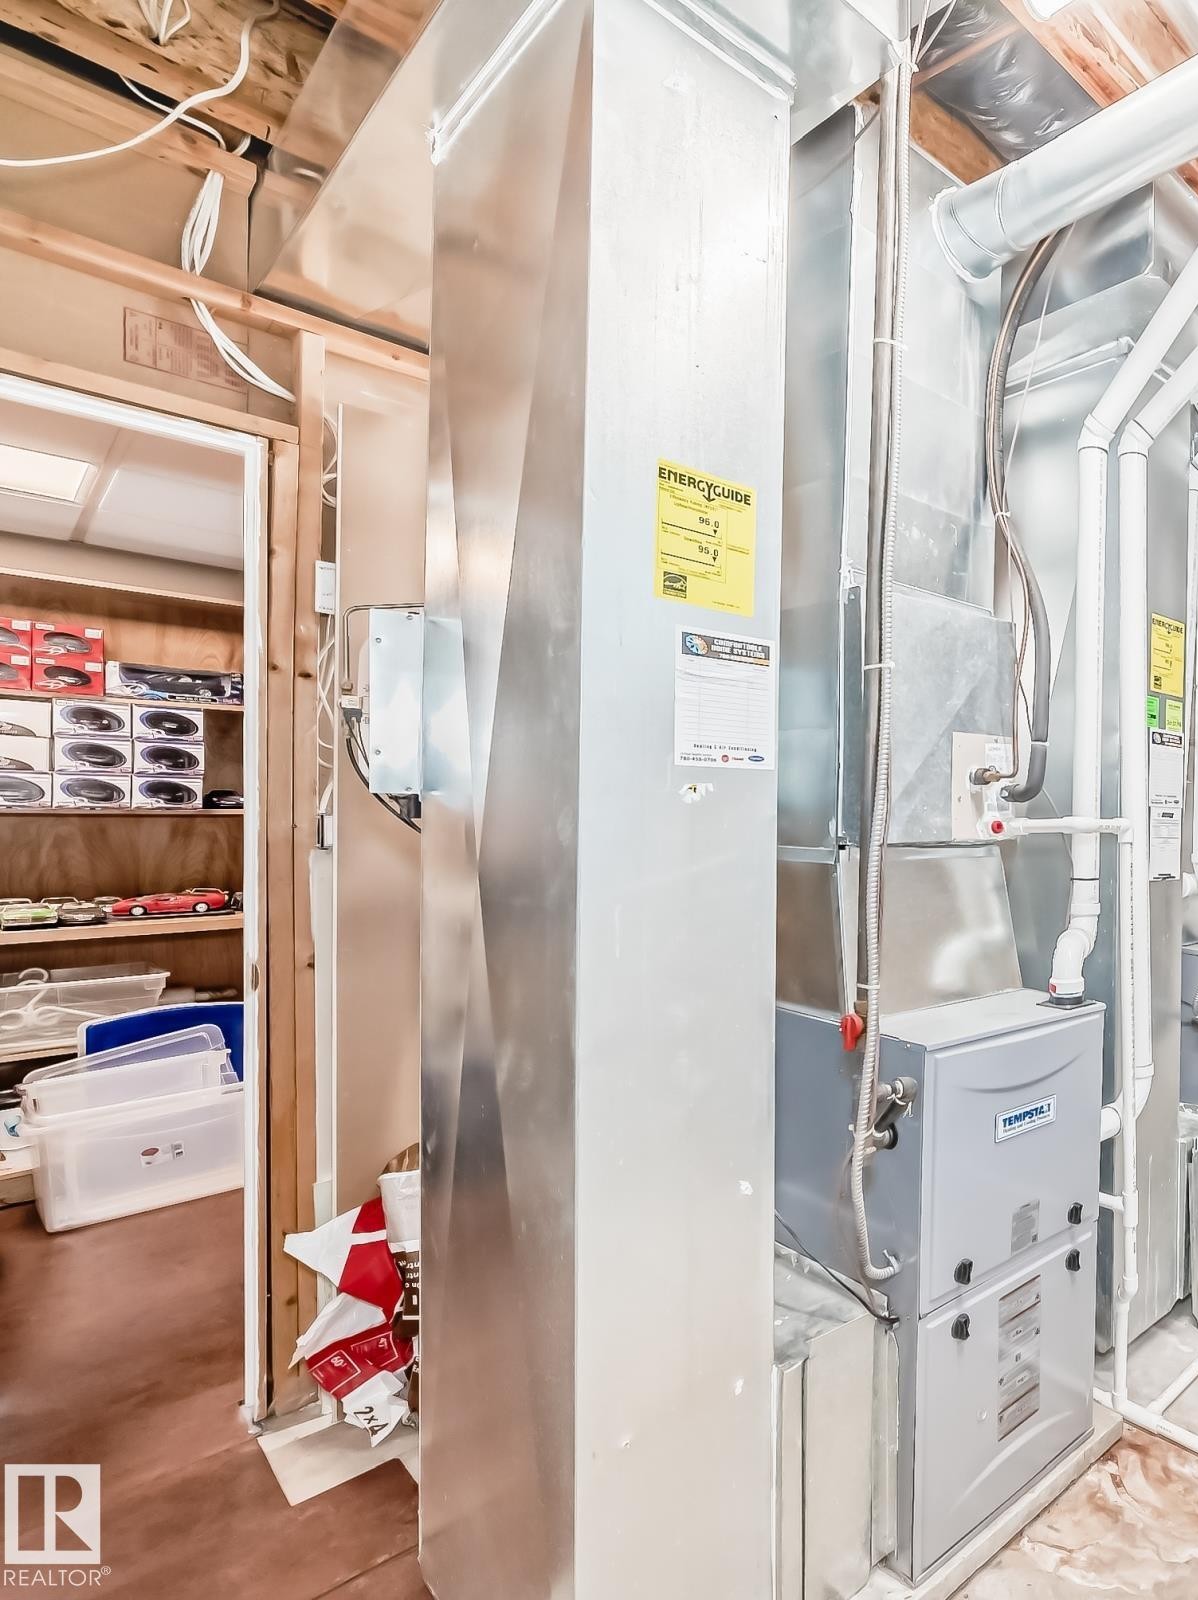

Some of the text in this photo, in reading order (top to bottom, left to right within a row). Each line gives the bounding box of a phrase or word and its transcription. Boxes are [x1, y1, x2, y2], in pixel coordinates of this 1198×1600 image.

[657, 466, 752, 506] ENERGYGUIDE
[698, 516, 720, 529] 96.0
[698, 545, 719, 558] 95.0
